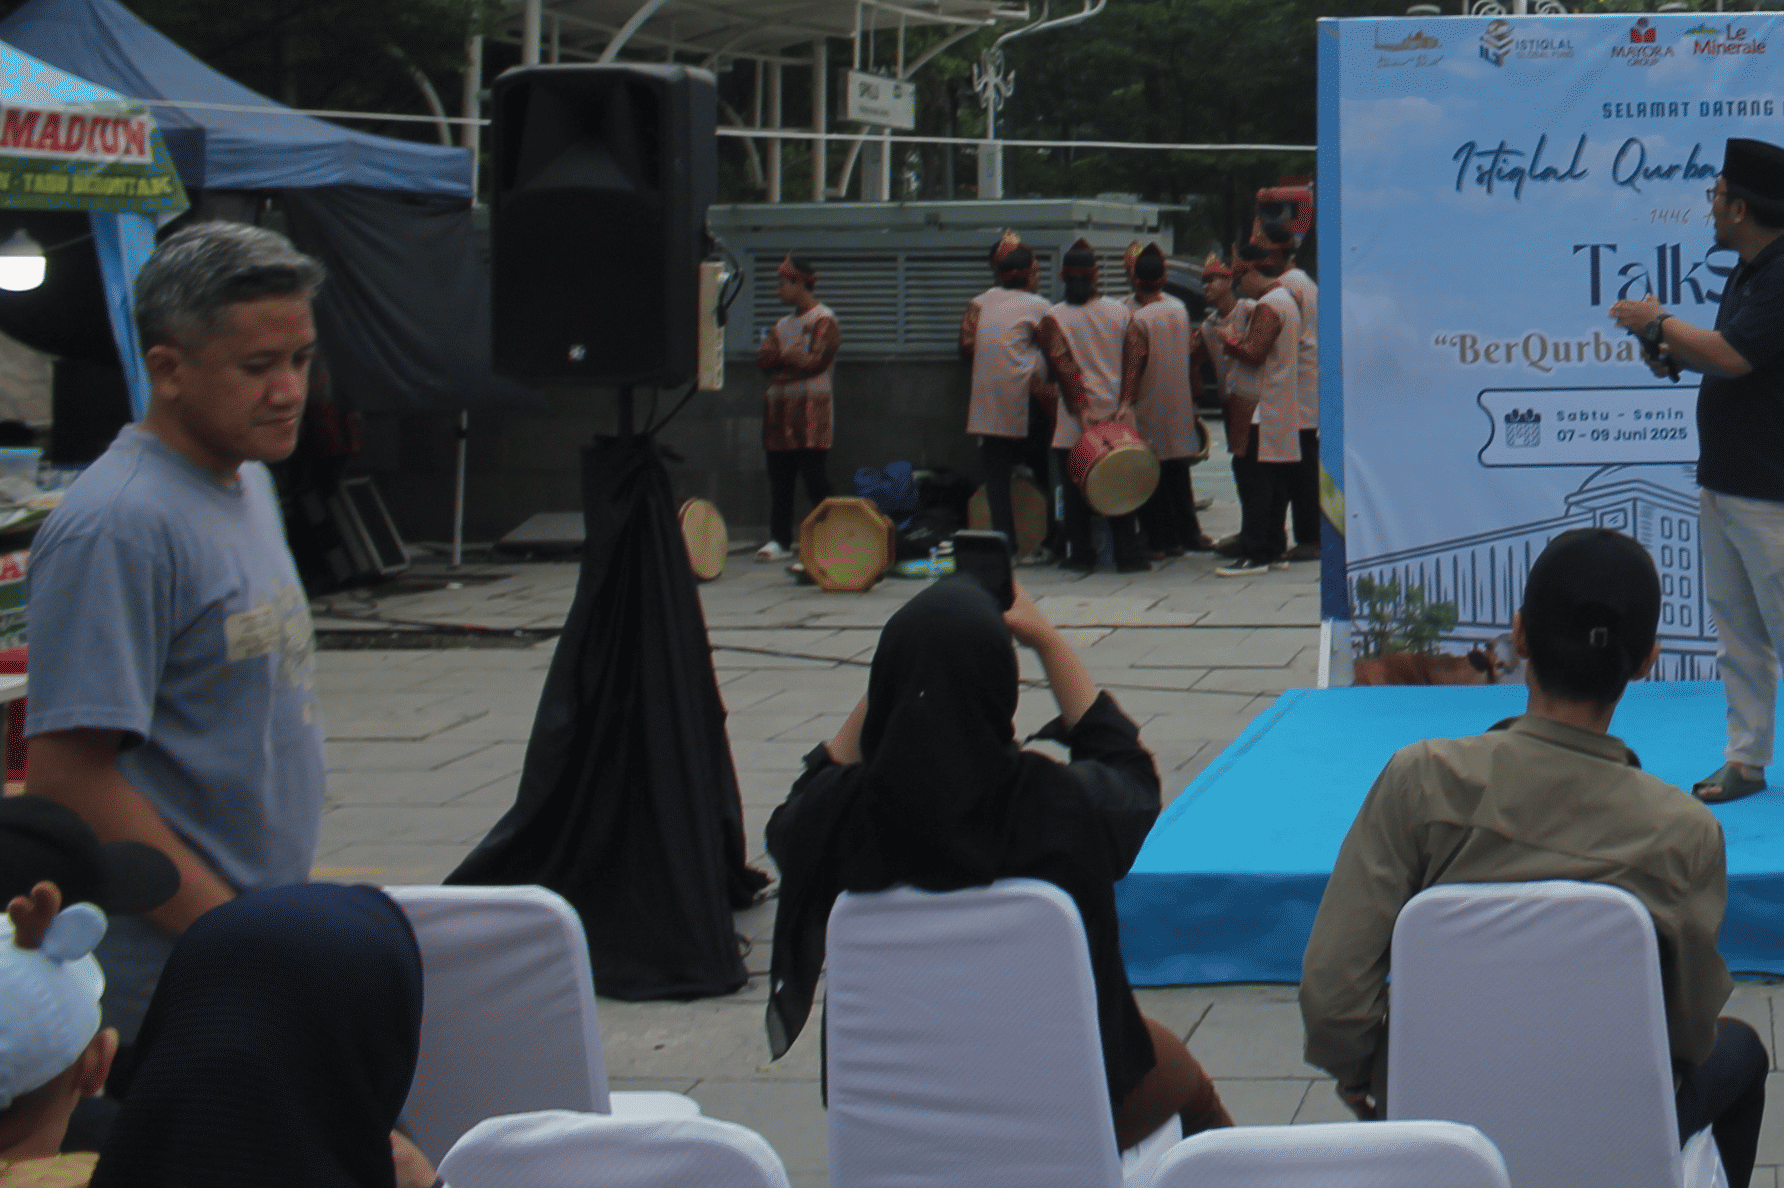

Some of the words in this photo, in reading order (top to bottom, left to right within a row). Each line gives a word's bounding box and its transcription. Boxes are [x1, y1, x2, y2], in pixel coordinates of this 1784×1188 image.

[1726, 24, 1747, 42] Le
[1515, 39, 1574, 51] ISTIQLAL
[1610, 45, 1675, 58] MAYORA
[1692, 39, 1767, 55] Minerale
[1602, 101, 1690, 119] SELAMAT
[1700, 99, 1773, 118] DATANG
[0, 108, 147, 157] MADIUN
[1452, 132, 1588, 202] Istiqlal
[1612, 137, 1724, 194] Qurba
[1556, 410, 1609, 423] Sabtu
[1633, 407, 1684, 422] Senin
[1556, 428, 1576, 442] 07
[1613, 426, 1647, 442] Juni
[1650, 427, 1688, 441] 2025
